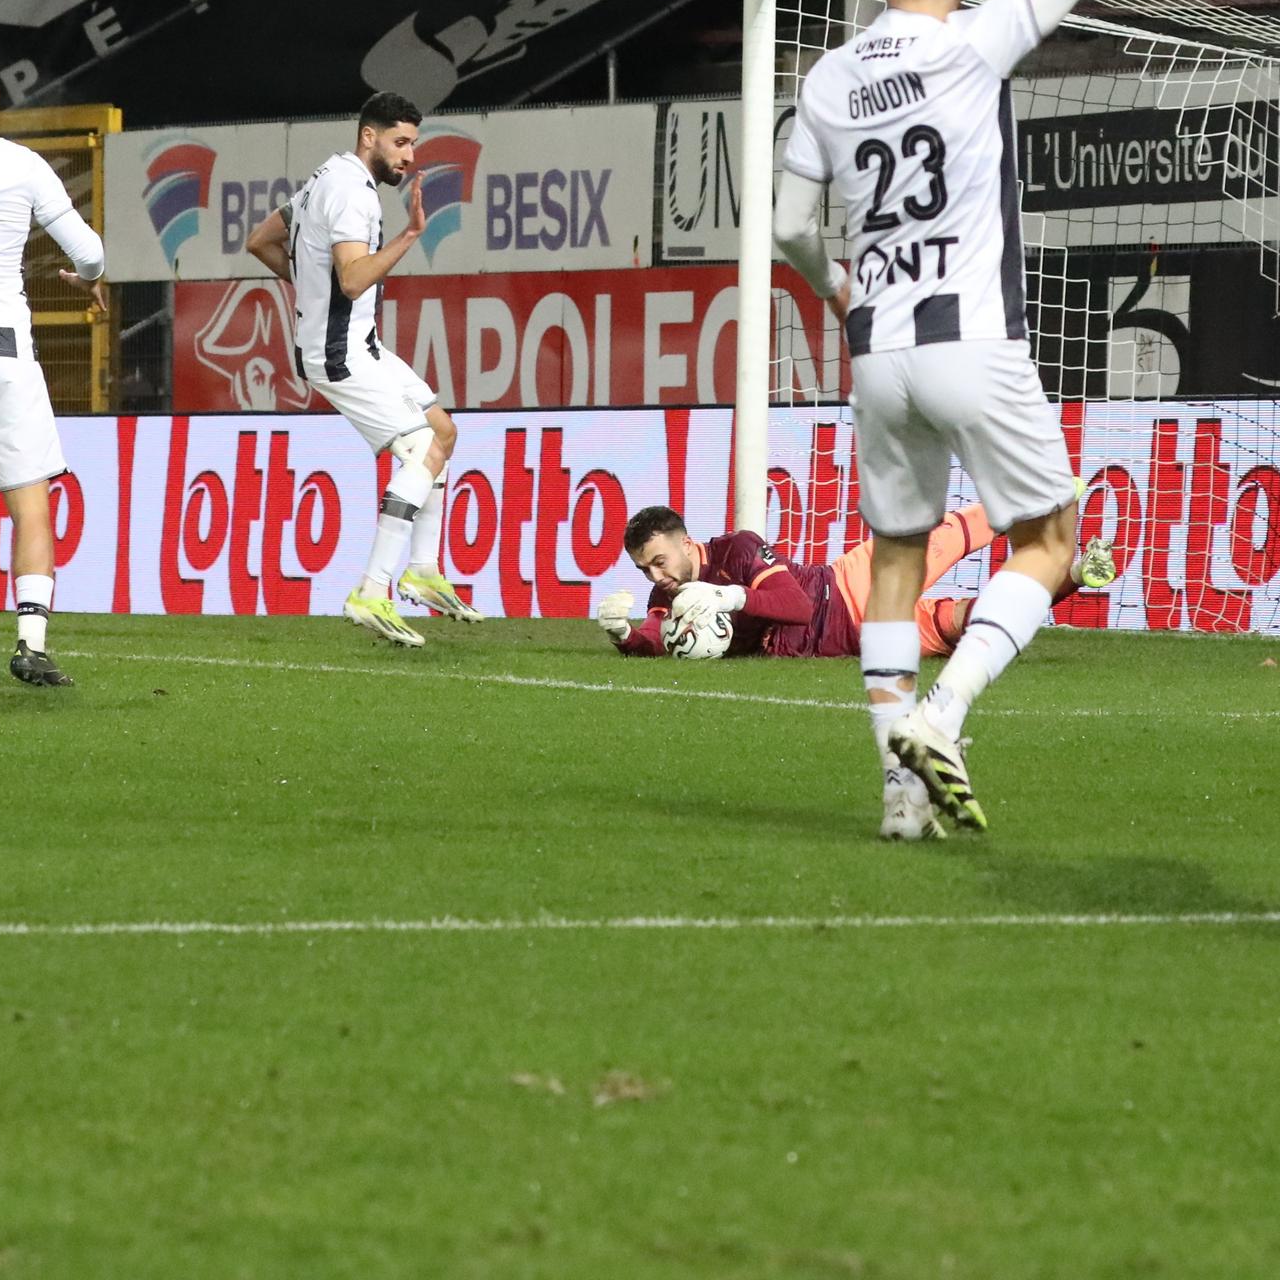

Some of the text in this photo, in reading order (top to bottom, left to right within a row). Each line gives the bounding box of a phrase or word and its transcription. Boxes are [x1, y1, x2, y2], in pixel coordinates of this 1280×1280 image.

[855, 35, 919, 55] UNIBET
[848, 71, 927, 120] GAUDIN
[486, 168, 612, 251] BESIX
[854, 123, 949, 233] 23
[160, 415, 342, 616] lotto
